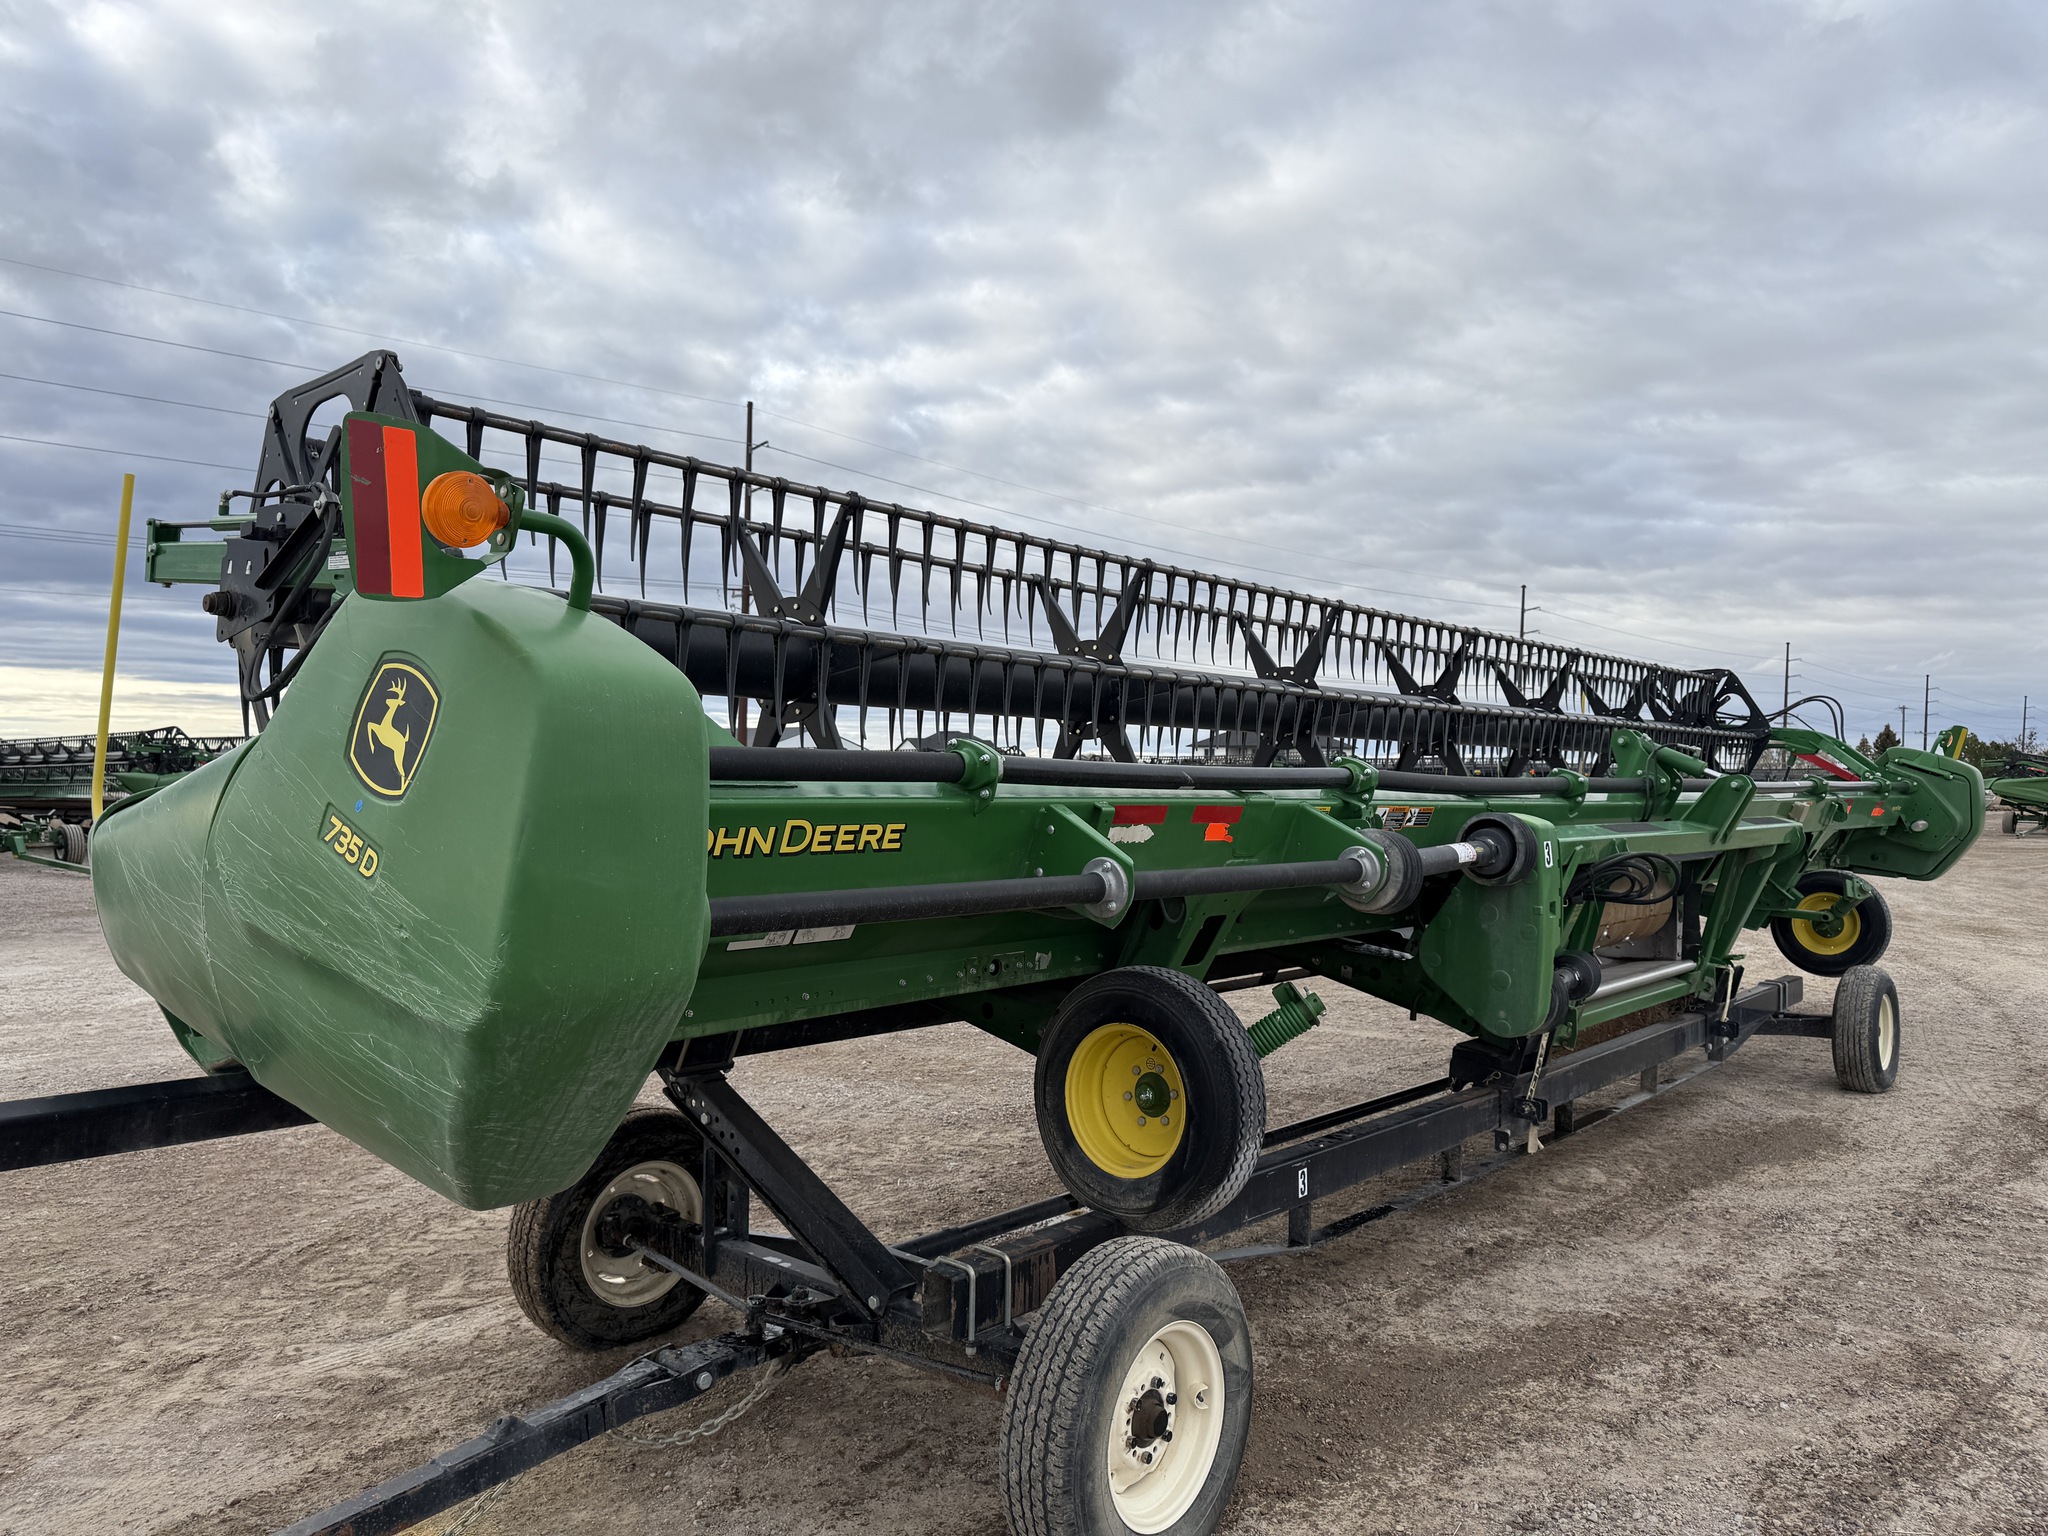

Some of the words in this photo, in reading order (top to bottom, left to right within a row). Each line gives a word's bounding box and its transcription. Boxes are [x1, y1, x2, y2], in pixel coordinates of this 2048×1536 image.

[778, 818, 906, 856] DEERE
[1545, 842, 1551, 866] 3
[1300, 1170, 1306, 1196] 3
